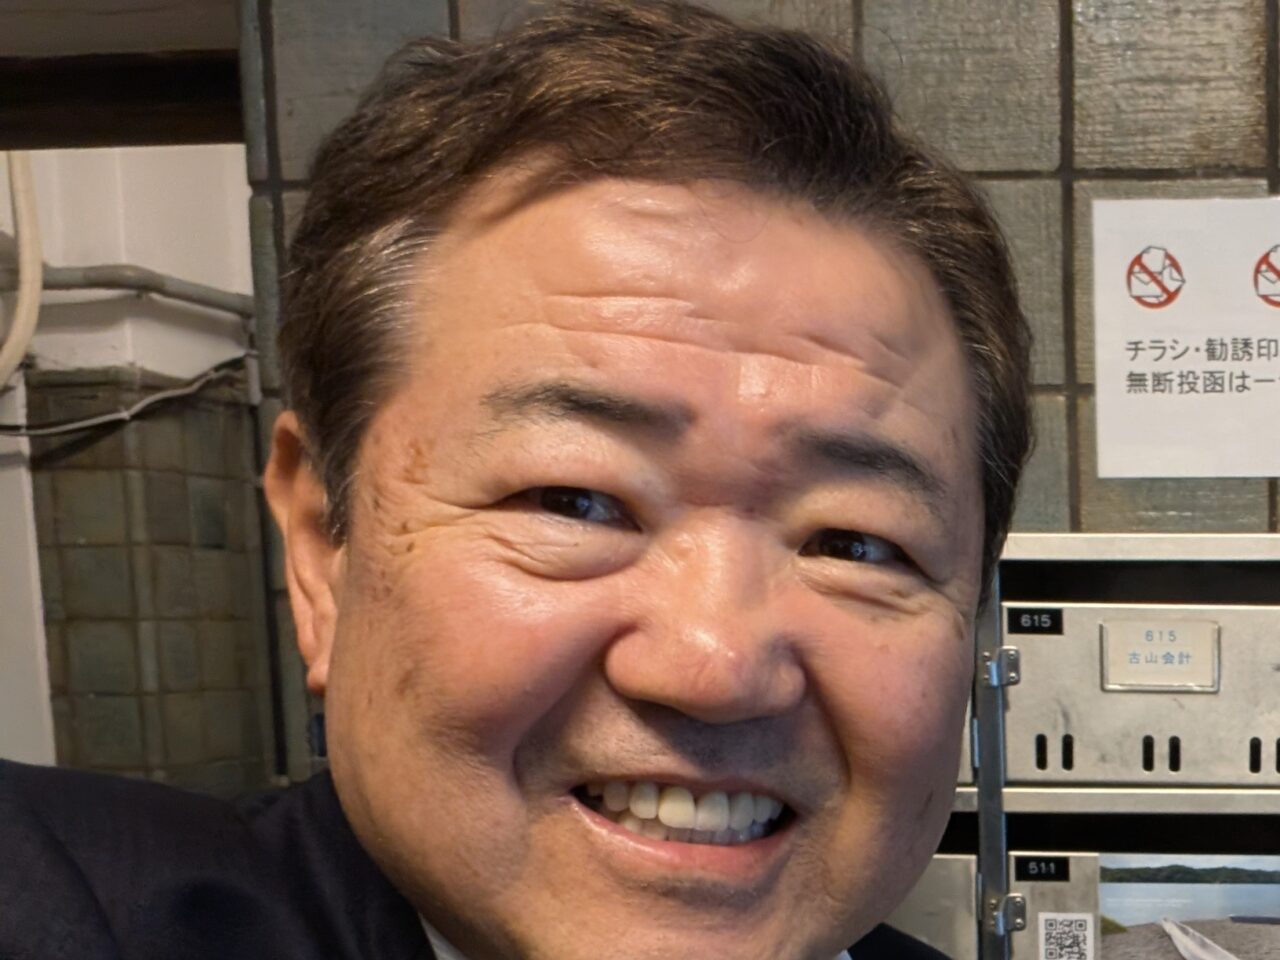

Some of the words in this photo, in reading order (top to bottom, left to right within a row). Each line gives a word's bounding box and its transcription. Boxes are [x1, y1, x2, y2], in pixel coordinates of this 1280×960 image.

[1020, 614, 1052, 628] 615
[1145, 630, 1177, 642] 615
[1028, 861, 1055, 875] 511
